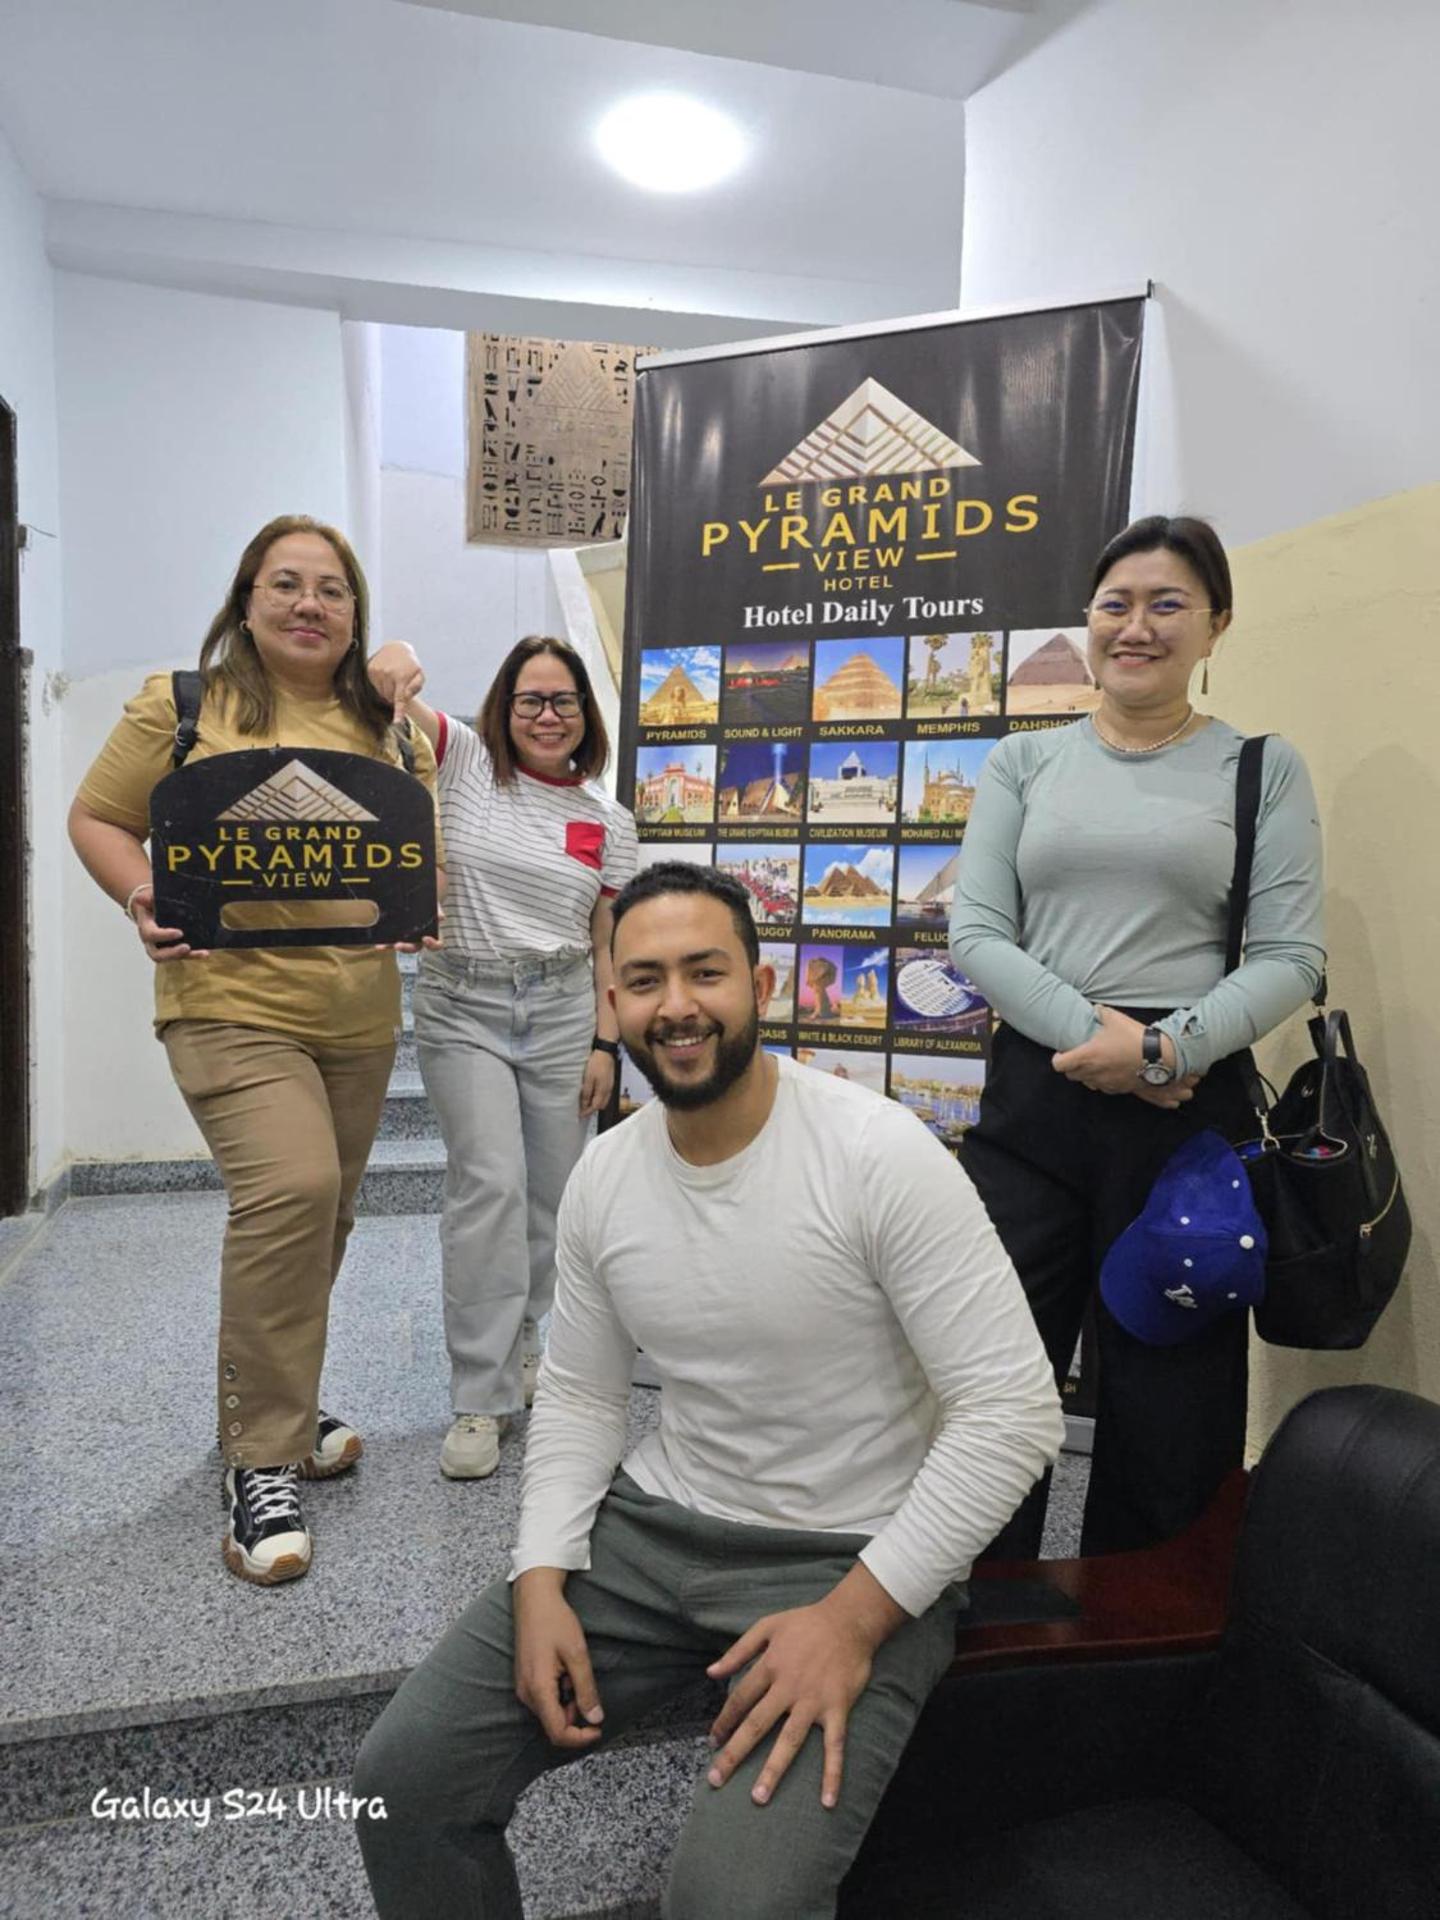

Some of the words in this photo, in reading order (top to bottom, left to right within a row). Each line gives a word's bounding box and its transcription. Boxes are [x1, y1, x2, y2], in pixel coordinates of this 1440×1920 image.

[765, 491, 801, 514] LE
[820, 478, 952, 508] GRAND
[702, 494, 1040, 557] PYRAMIDS
[812, 546, 905, 573] VIEW
[823, 575, 894, 592] HOTEL
[743, 602, 814, 629] Hotel
[822, 599, 894, 626] Daily
[903, 596, 984, 621] Tours
[646, 728, 707, 741] PYRAMIDS
[724, 727, 759, 739] SOUND
[761, 728, 769, 738] &
[771, 726, 803, 738] LIGHT
[819, 724, 885, 736] SAKKARA
[916, 721, 981, 735] MEMPHIS
[219, 826, 251, 842] LE
[264, 826, 362, 842] GRAND
[167, 843, 423, 872] PYRAMIDS
[261, 871, 333, 888] VIEW
[812, 927, 876, 941] PANORAMA
